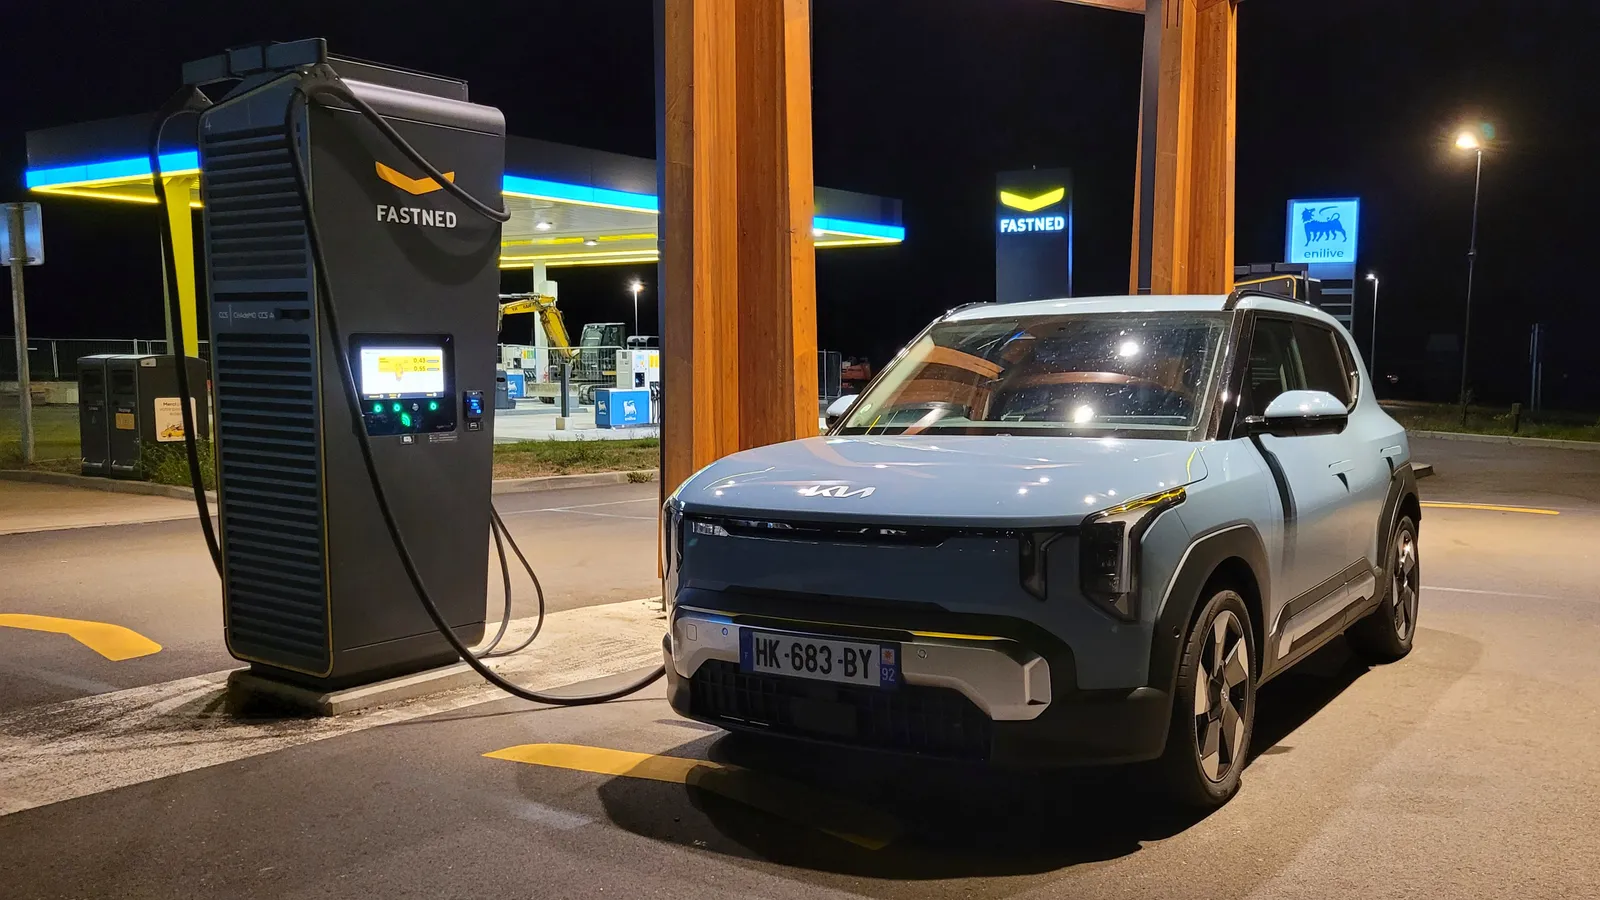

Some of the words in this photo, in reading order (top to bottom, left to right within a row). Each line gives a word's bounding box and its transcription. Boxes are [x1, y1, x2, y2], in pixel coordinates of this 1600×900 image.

[377, 205, 457, 228] FASTNED
[1000, 217, 1065, 233] FASTNED
[1304, 249, 1344, 258] enilive
[881, 667, 895, 682] 92
